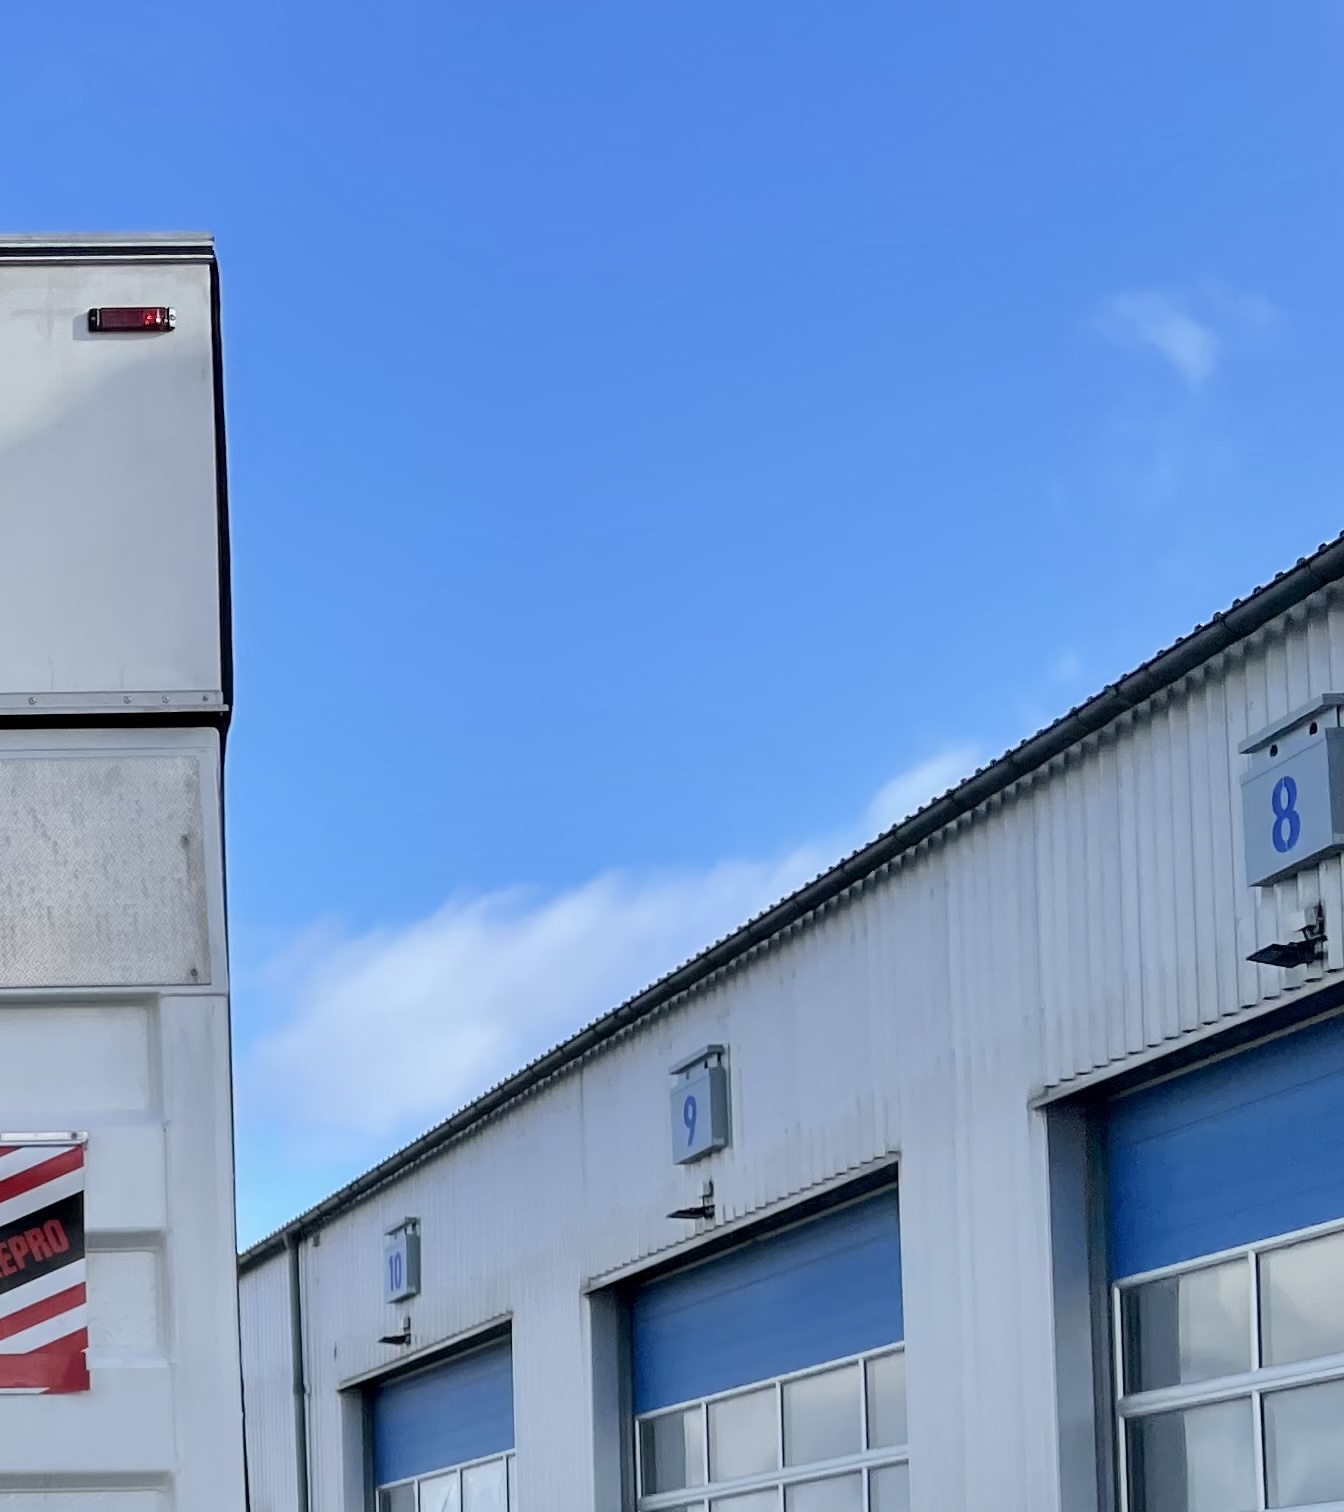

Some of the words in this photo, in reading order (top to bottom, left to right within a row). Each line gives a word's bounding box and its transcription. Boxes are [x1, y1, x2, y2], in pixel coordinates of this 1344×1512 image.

[1271, 775, 1301, 853] 8
[683, 1095, 697, 1146] 9
[389, 1251, 402, 1292] 10
